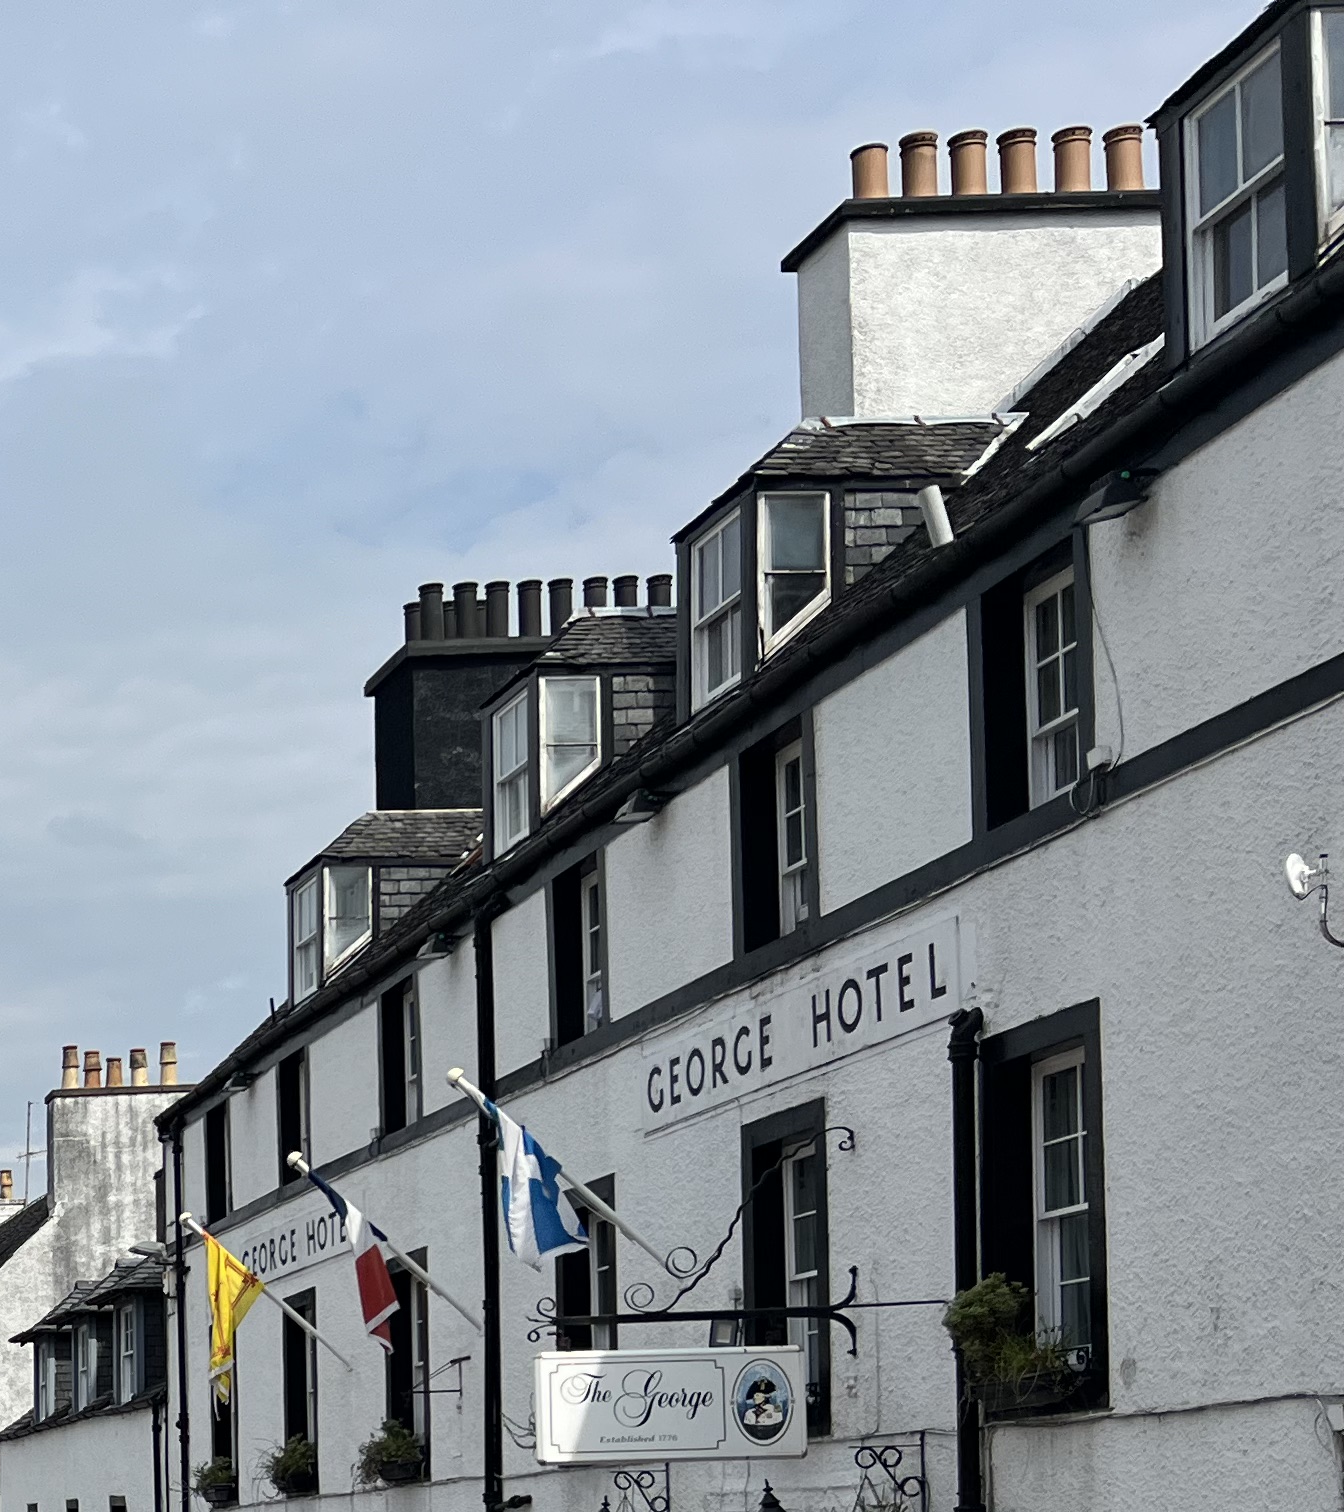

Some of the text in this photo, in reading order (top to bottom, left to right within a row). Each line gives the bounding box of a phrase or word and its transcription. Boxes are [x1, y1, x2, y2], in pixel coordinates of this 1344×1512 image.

[647, 943, 947, 1113] GEORGE HOTEL
[242, 1209, 347, 1277] GEORGE HOTE
[560, 1368, 714, 1429] The George
[599, 1434, 656, 1444] Established
